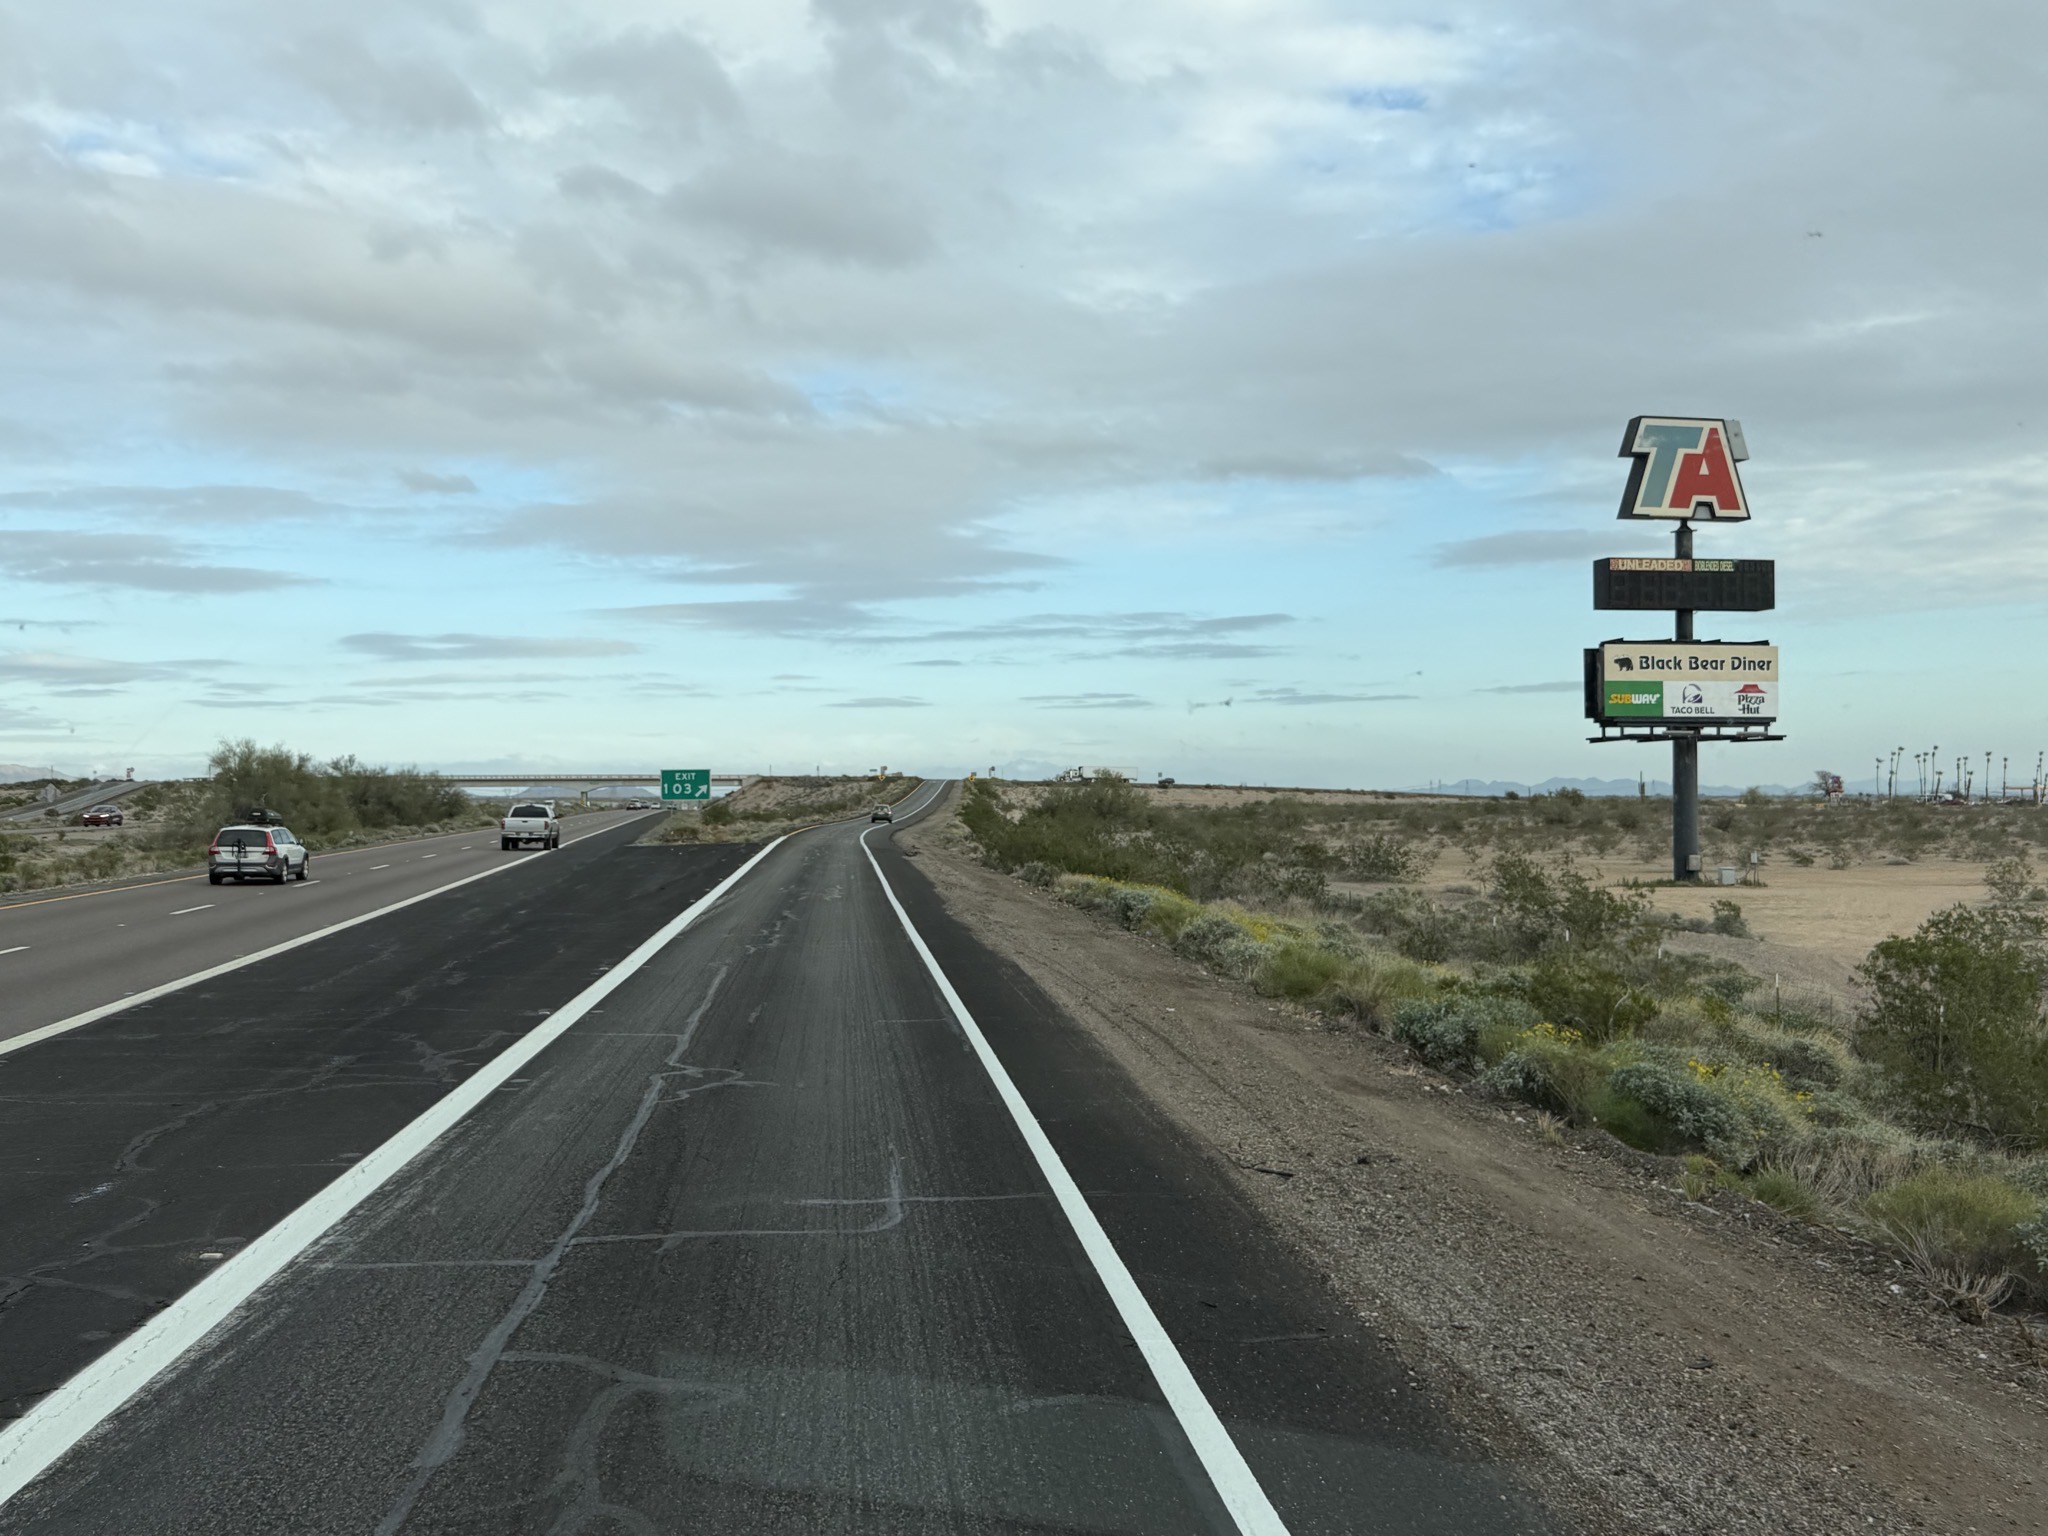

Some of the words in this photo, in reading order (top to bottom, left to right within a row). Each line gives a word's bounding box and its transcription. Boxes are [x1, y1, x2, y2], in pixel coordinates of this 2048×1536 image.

[1637, 424, 1741, 511] TA
[1618, 559, 1683, 571] UNLEADED
[1639, 655, 1682, 671] Black
[1688, 656, 1726, 671] Bear
[1730, 656, 1772, 671] Diner
[1608, 693, 1660, 704] SUBWAY
[1737, 694, 1765, 705] Pizza
[1670, 706, 1693, 715] TACO
[1694, 706, 1715, 715] BELL
[1738, 704, 1760, 714] Hut
[675, 772, 696, 781] EXIT
[663, 783, 692, 795] 103
